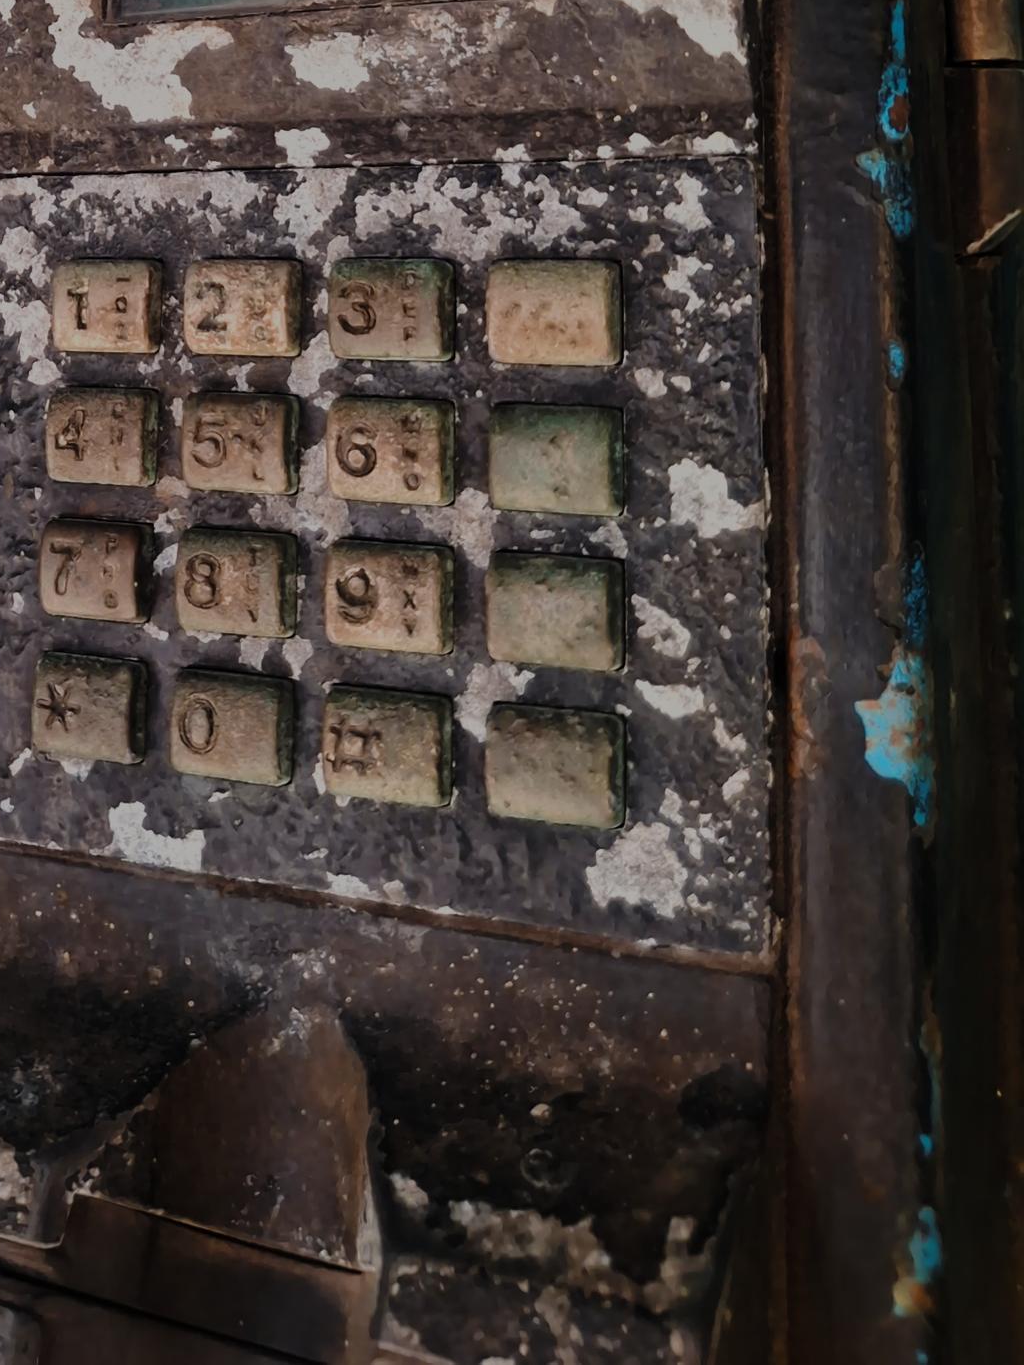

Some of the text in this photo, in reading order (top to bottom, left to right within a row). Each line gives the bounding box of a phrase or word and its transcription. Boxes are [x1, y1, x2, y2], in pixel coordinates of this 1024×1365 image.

[67, 279, 88, 330] 1
[196, 281, 227, 333] 2
[337, 278, 378, 336] 3
[55, 408, 85, 461] 4
[192, 412, 226, 468] 5
[336, 421, 378, 478] 6
[50, 537, 83, 596] 7
[184, 551, 221, 610] 8
[336, 565, 378, 625] 9
